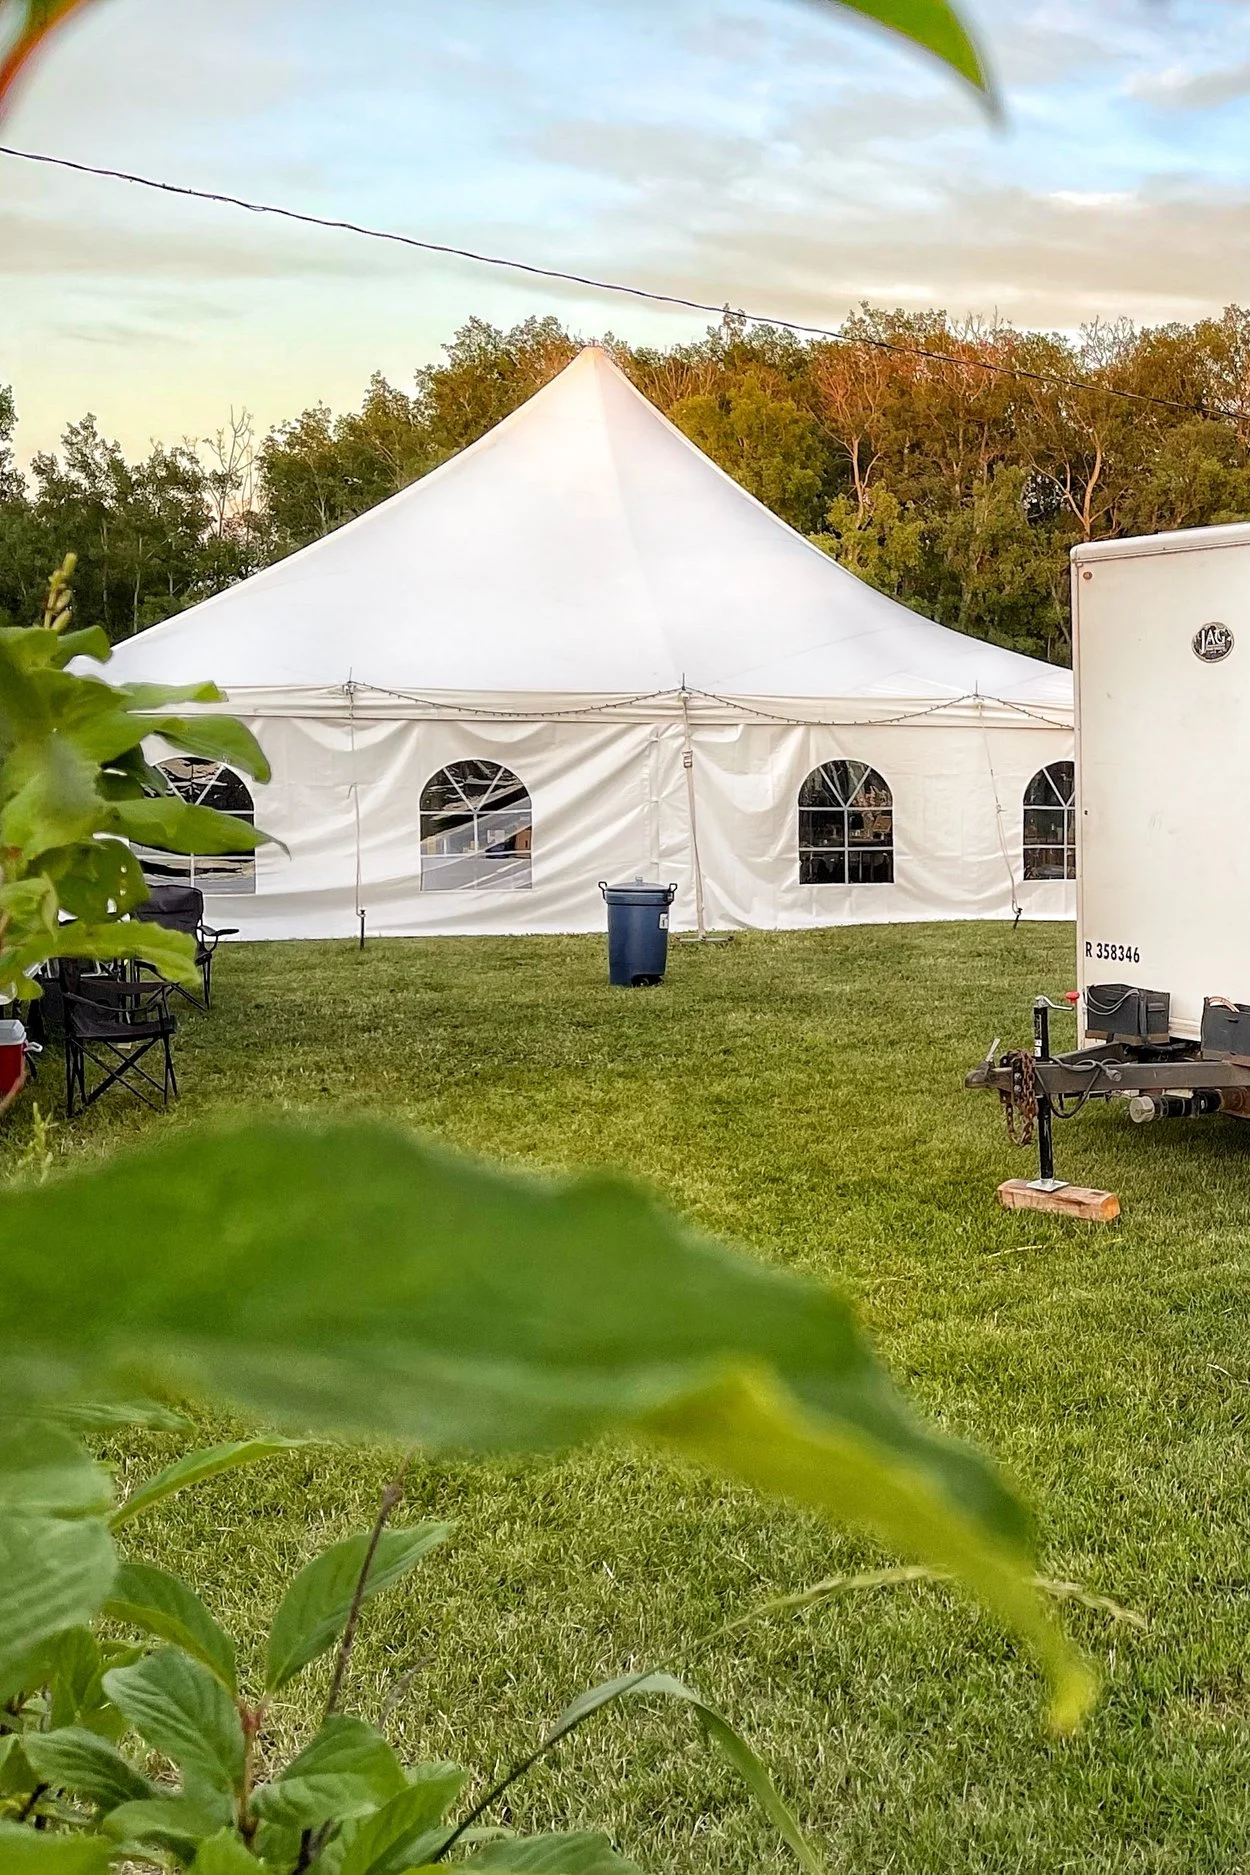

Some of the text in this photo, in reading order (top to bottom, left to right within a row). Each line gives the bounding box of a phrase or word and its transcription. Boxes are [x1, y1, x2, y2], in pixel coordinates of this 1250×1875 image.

[1200, 629, 1226, 654] JAG
[1085, 941, 1140, 963] R 358346
